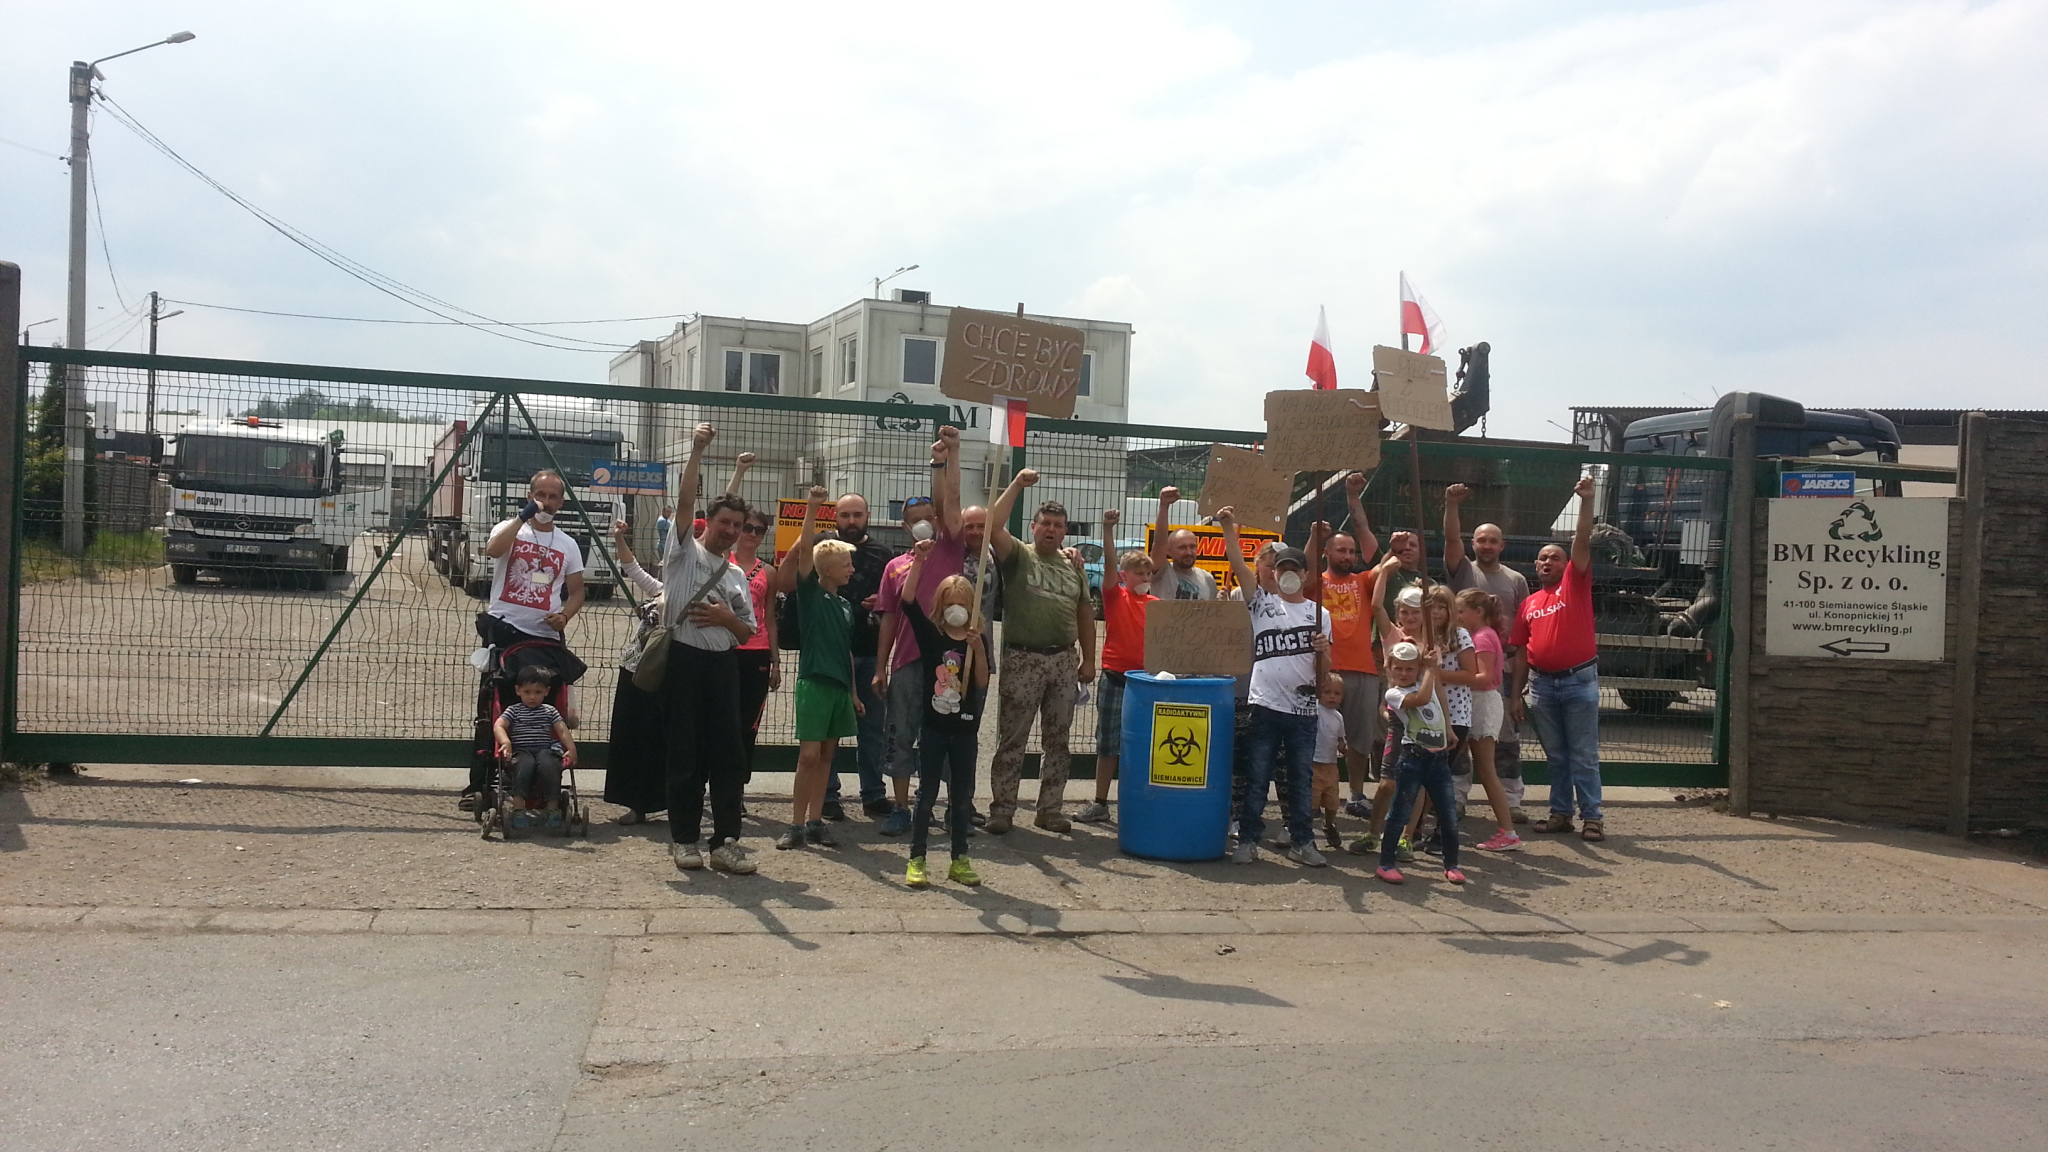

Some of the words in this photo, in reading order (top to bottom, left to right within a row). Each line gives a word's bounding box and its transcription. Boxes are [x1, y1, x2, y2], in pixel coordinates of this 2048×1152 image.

[962, 321, 1031, 358] CHCE
[963, 354, 1076, 399] ZDROWY
[103, 425, 109, 434] 5
[612, 470, 663, 483] JAREXS
[1802, 479, 1850, 489] JAREXS
[778, 519, 803, 528] OBIEK
[513, 544, 561, 570] POLSKA
[1773, 543, 1814, 562] BM
[1823, 544, 1941, 570] Recykling
[1798, 570, 1833, 594] Sp.
[1841, 576, 1853, 589] z
[1861, 576, 1880, 590] o.
[1888, 577, 1908, 591] o.
[1526, 600, 1566, 622] POLSKA
[1783, 601, 1816, 609] 41-100
[1818, 601, 1888, 611] Siemianowice
[1891, 600, 1928, 611] Śląskie
[1808, 611, 1821, 619] ul.
[1824, 611, 1890, 622] Konopnickiej
[1792, 621, 1912, 635] www.bmrecykling.pl
[1158, 708, 1206, 718] RADIOAKTYWNE
[1153, 773, 1203, 783] SIEMIANOWICE
